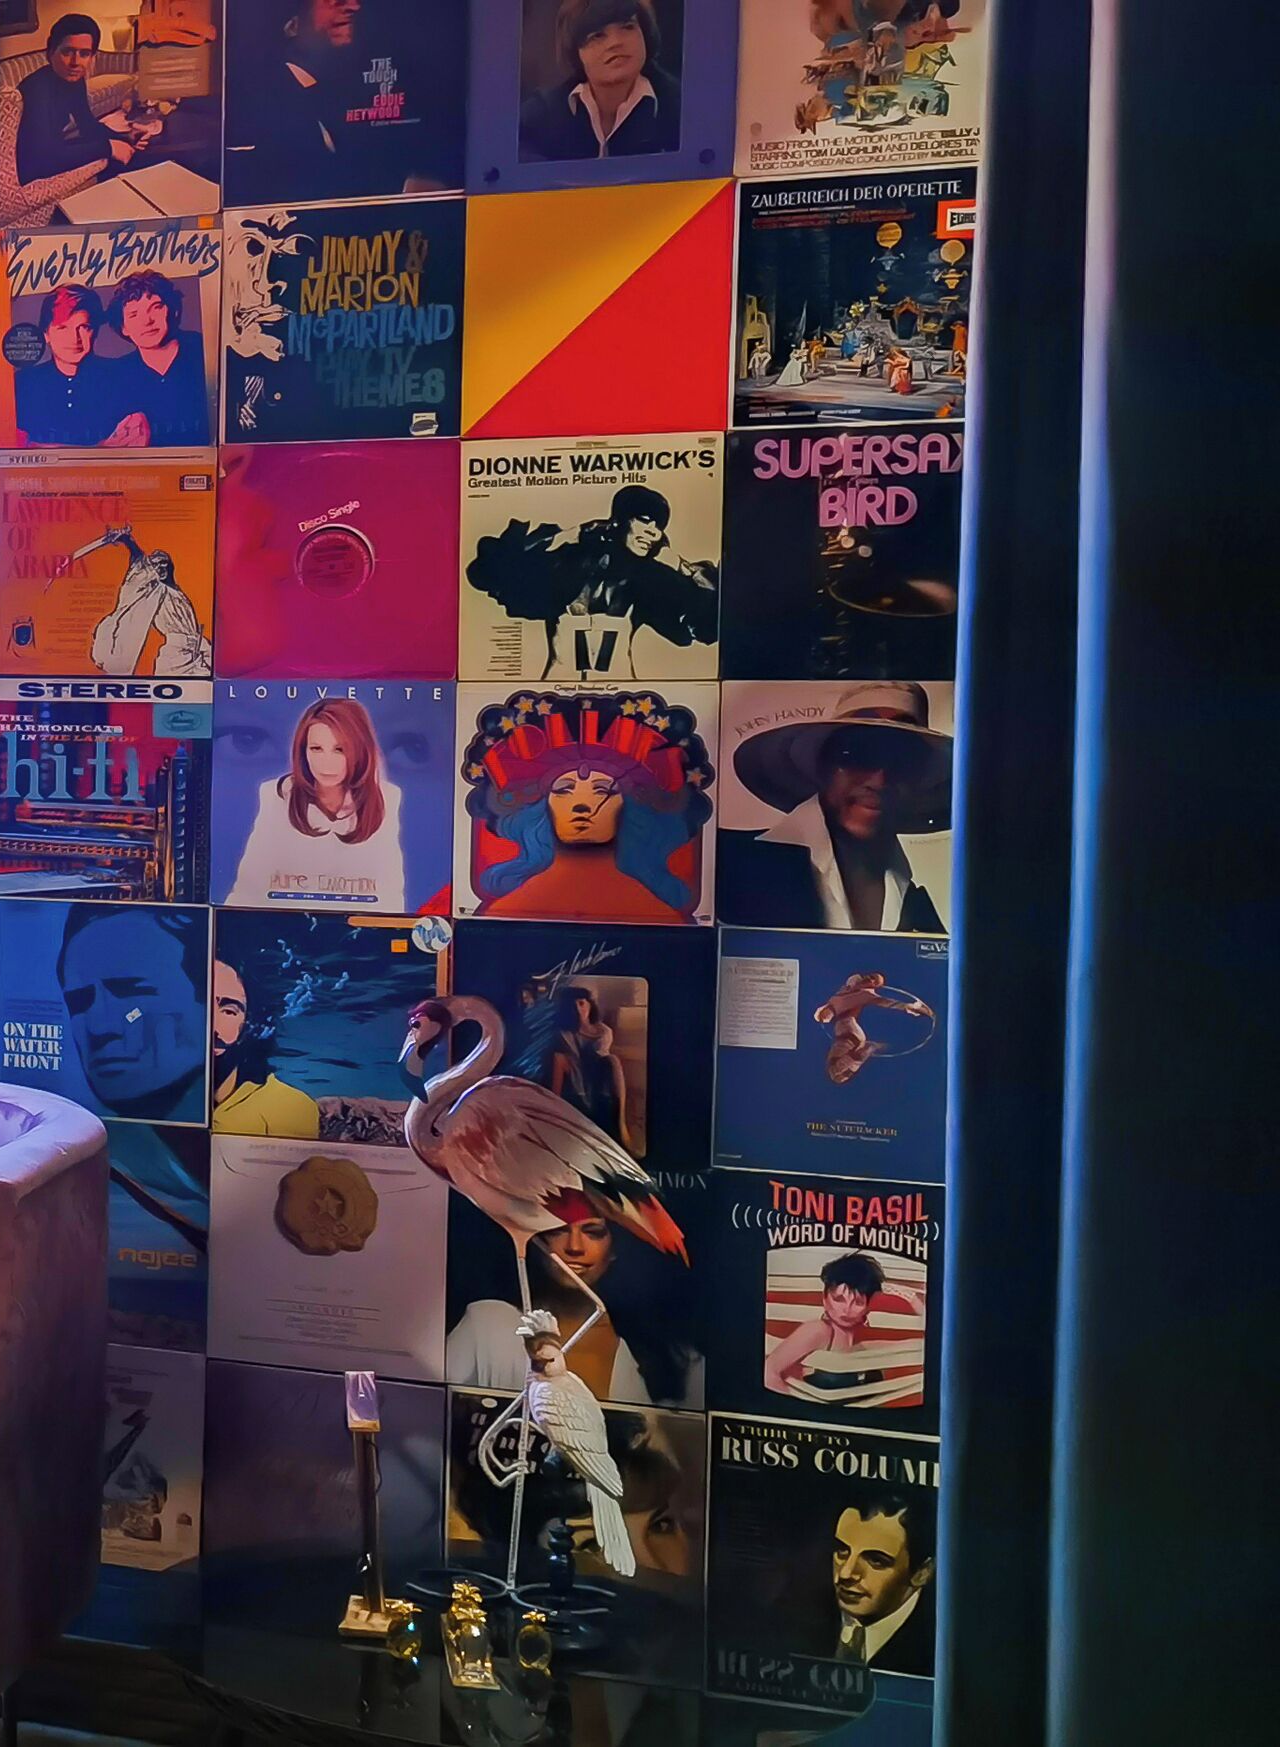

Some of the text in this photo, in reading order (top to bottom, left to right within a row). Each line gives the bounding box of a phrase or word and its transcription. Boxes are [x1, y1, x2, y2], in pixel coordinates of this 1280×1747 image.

[363, 69, 397, 83] TOUCH
[371, 57, 392, 71] THE
[373, 92, 405, 107] EDDIE
[751, 142, 785, 152] MUSIC
[822, 138, 842, 147] THE
[845, 134, 889, 146] MOTION
[890, 131, 936, 143] PICTURE
[751, 139, 962, 162] STARRING TOM LAUGHLIN AND DELORES
[751, 180, 962, 208] ZAUBERREICH DER OPERETTE
[106, 222, 221, 280] Brothers
[307, 229, 404, 278] JIMMY
[300, 270, 421, 317] MARION
[9, 455, 48, 464] STEREO
[468, 449, 716, 476] DIONNE WARWICK'S
[468, 472, 647, 488] Greatest Motion Picture Hits
[2, 493, 130, 523] LAWRENCE
[298, 500, 360, 532] Disco Single
[819, 486, 918, 527] BIRD
[7, 526, 38, 551] OF
[17, 682, 183, 699] STEREO
[734, 706, 826, 738] JOHN HANDY
[40, 734, 71, 742] THE
[3, 1022, 63, 1039] ON THE
[3, 1053, 63, 1071] FRONT
[769, 1180, 929, 1225] TONI BASIL
[767, 1224, 928, 1260] WORD OF MOUTH
[117, 1248, 197, 1270] najee
[721, 1436, 799, 1468] RUSS
[823, 1434, 850, 1447] TO
